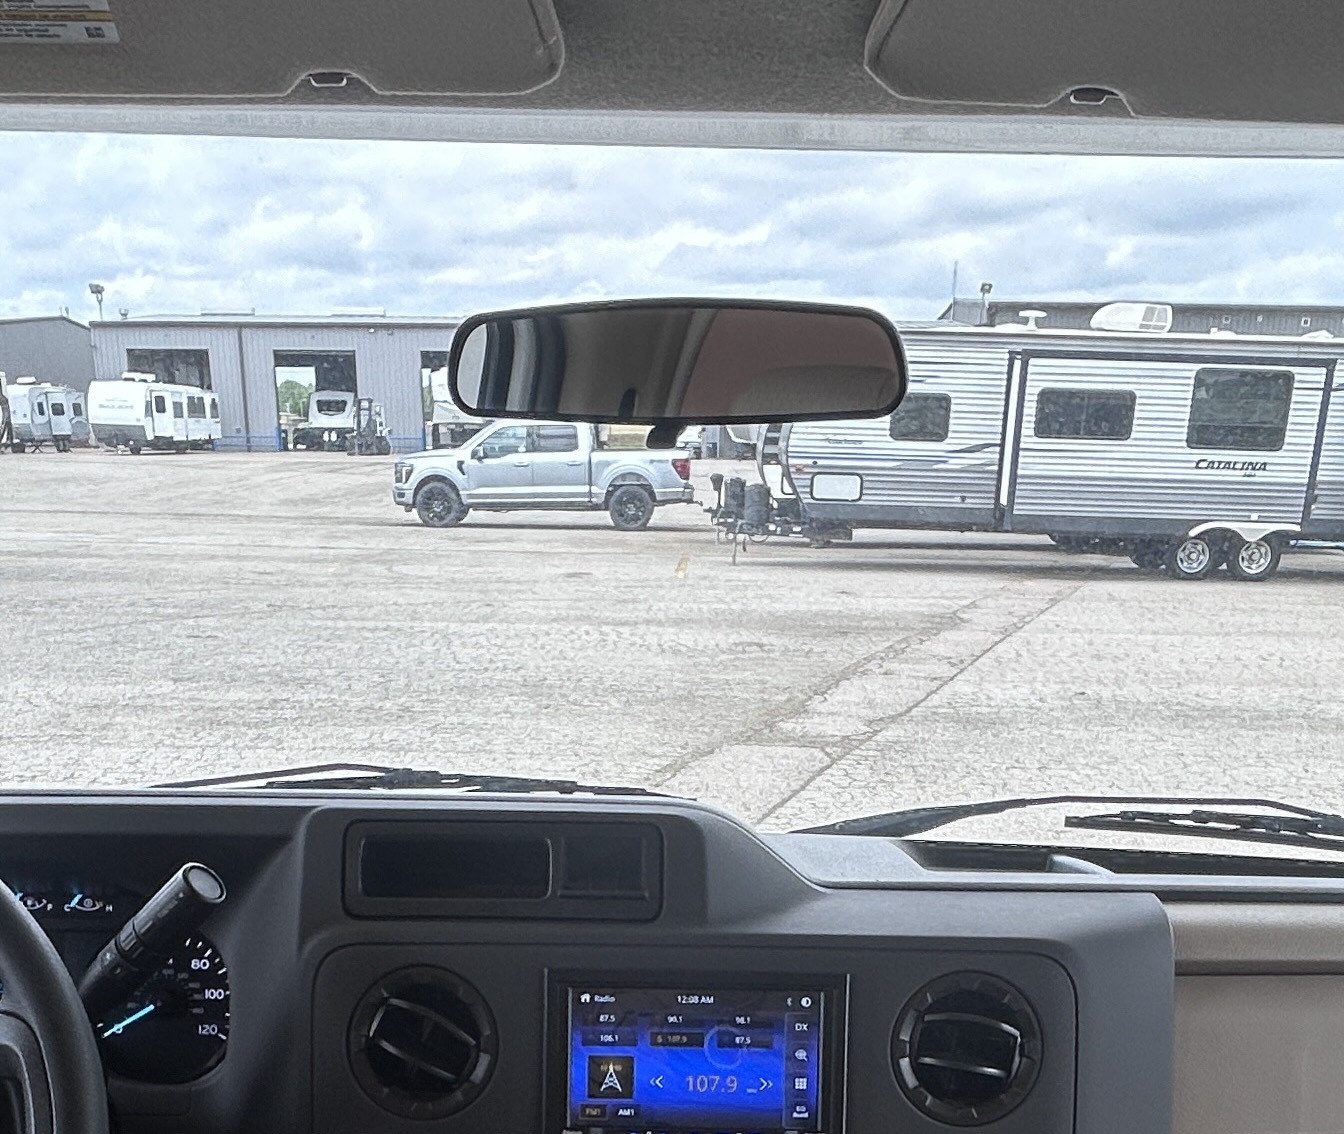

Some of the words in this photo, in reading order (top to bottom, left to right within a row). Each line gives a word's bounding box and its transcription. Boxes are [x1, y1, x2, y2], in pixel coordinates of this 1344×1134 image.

[1194, 458, 1268, 471] CATALINA
[106, 904, 113, 912] H
[190, 959, 210, 970] 80
[204, 988, 225, 1000] 100
[594, 995, 615, 1003] Radio
[677, 995, 698, 1004] 12:08
[700, 995, 714, 1004] AM
[599, 1014, 615, 1022] 87.5
[198, 1024, 218, 1035] 120
[795, 1023, 808, 1031] DX
[735, 1036, 751, 1045] 87.5
[686, 1076, 737, 1093] 107.9
[618, 1108, 635, 1117] AM1
